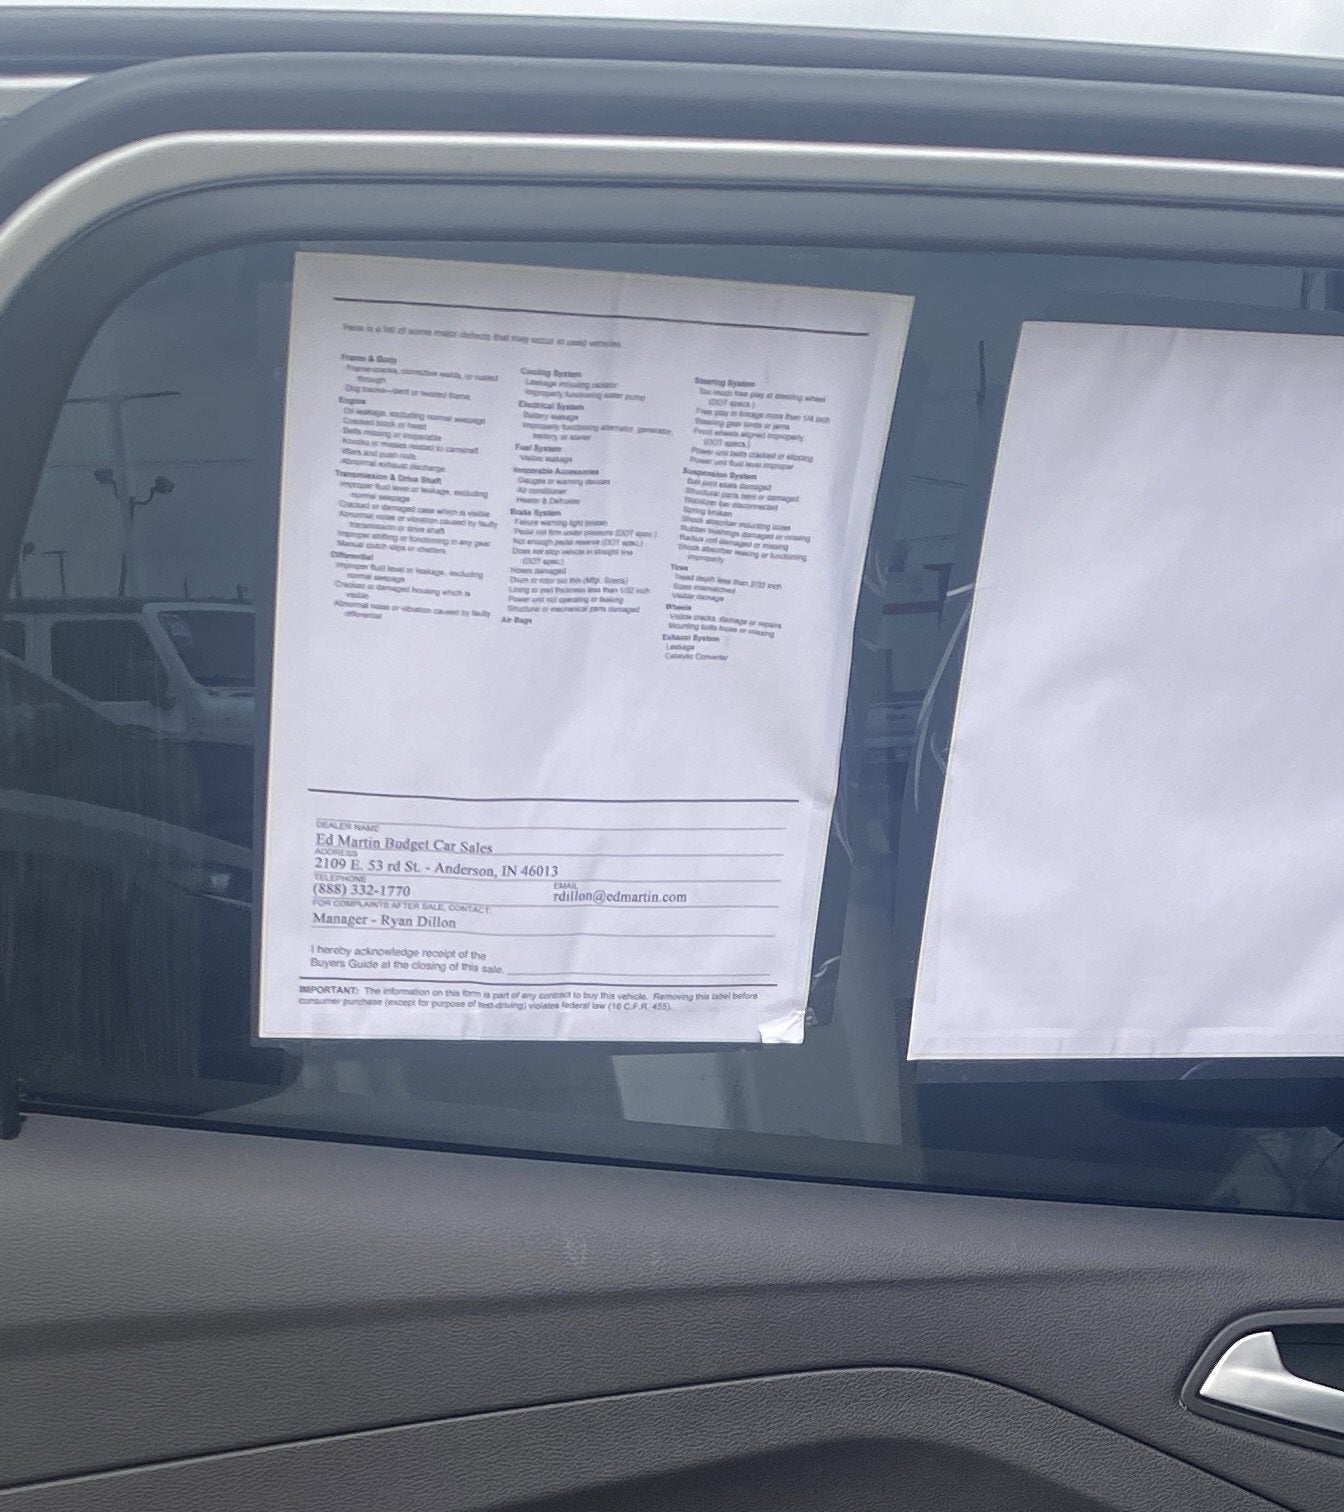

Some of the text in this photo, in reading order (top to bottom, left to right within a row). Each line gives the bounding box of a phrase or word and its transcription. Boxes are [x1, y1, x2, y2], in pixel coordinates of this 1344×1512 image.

[316, 832, 492, 855] Ed Martin Budget Car Sales
[314, 857, 346, 869] 2109
[350, 858, 363, 871] E.
[368, 859, 382, 871] 53
[387, 860, 400, 872] rd
[404, 860, 418, 872] St.
[434, 865, 496, 879] Anderson,
[502, 865, 517, 876] IN
[521, 864, 558, 876] 46013
[312, 883, 410, 896] (888) 332-1770
[553, 892, 686, 905] rdillon@edmartin.com
[312, 914, 367, 927] Manager
[380, 914, 412, 928] Ryan
[417, 915, 456, 928] Dillon
[310, 944, 486, 960] I hereby acknowledge receipt of the
[309, 957, 504, 974] Buyers Guide at the closing of this sale.
[298, 985, 359, 994] IMPORTANT:
[365, 986, 380, 994] The
[382, 987, 430, 995] information
[445, 989, 460, 997] this
[462, 989, 481, 997] form
[492, 992, 509, 1000] part
[511, 991, 520, 999] of
[521, 992, 536, 1001] any
[538, 991, 571, 999] contract
[583, 992, 598, 1000] buy
[652, 993, 693, 1001] Removing
[298, 997, 340, 1005] consumer
[342, 998, 382, 1006] purchase
[384, 999, 416, 1007] (except
[417, 998, 428, 1006] for
[431, 1000, 465, 1009] purpose
[467, 999, 476, 1007] of
[477, 1001, 526, 1010] test-driving)
[561, 1001, 590, 1009] federal
[607, 1002, 622, 1011] (16
